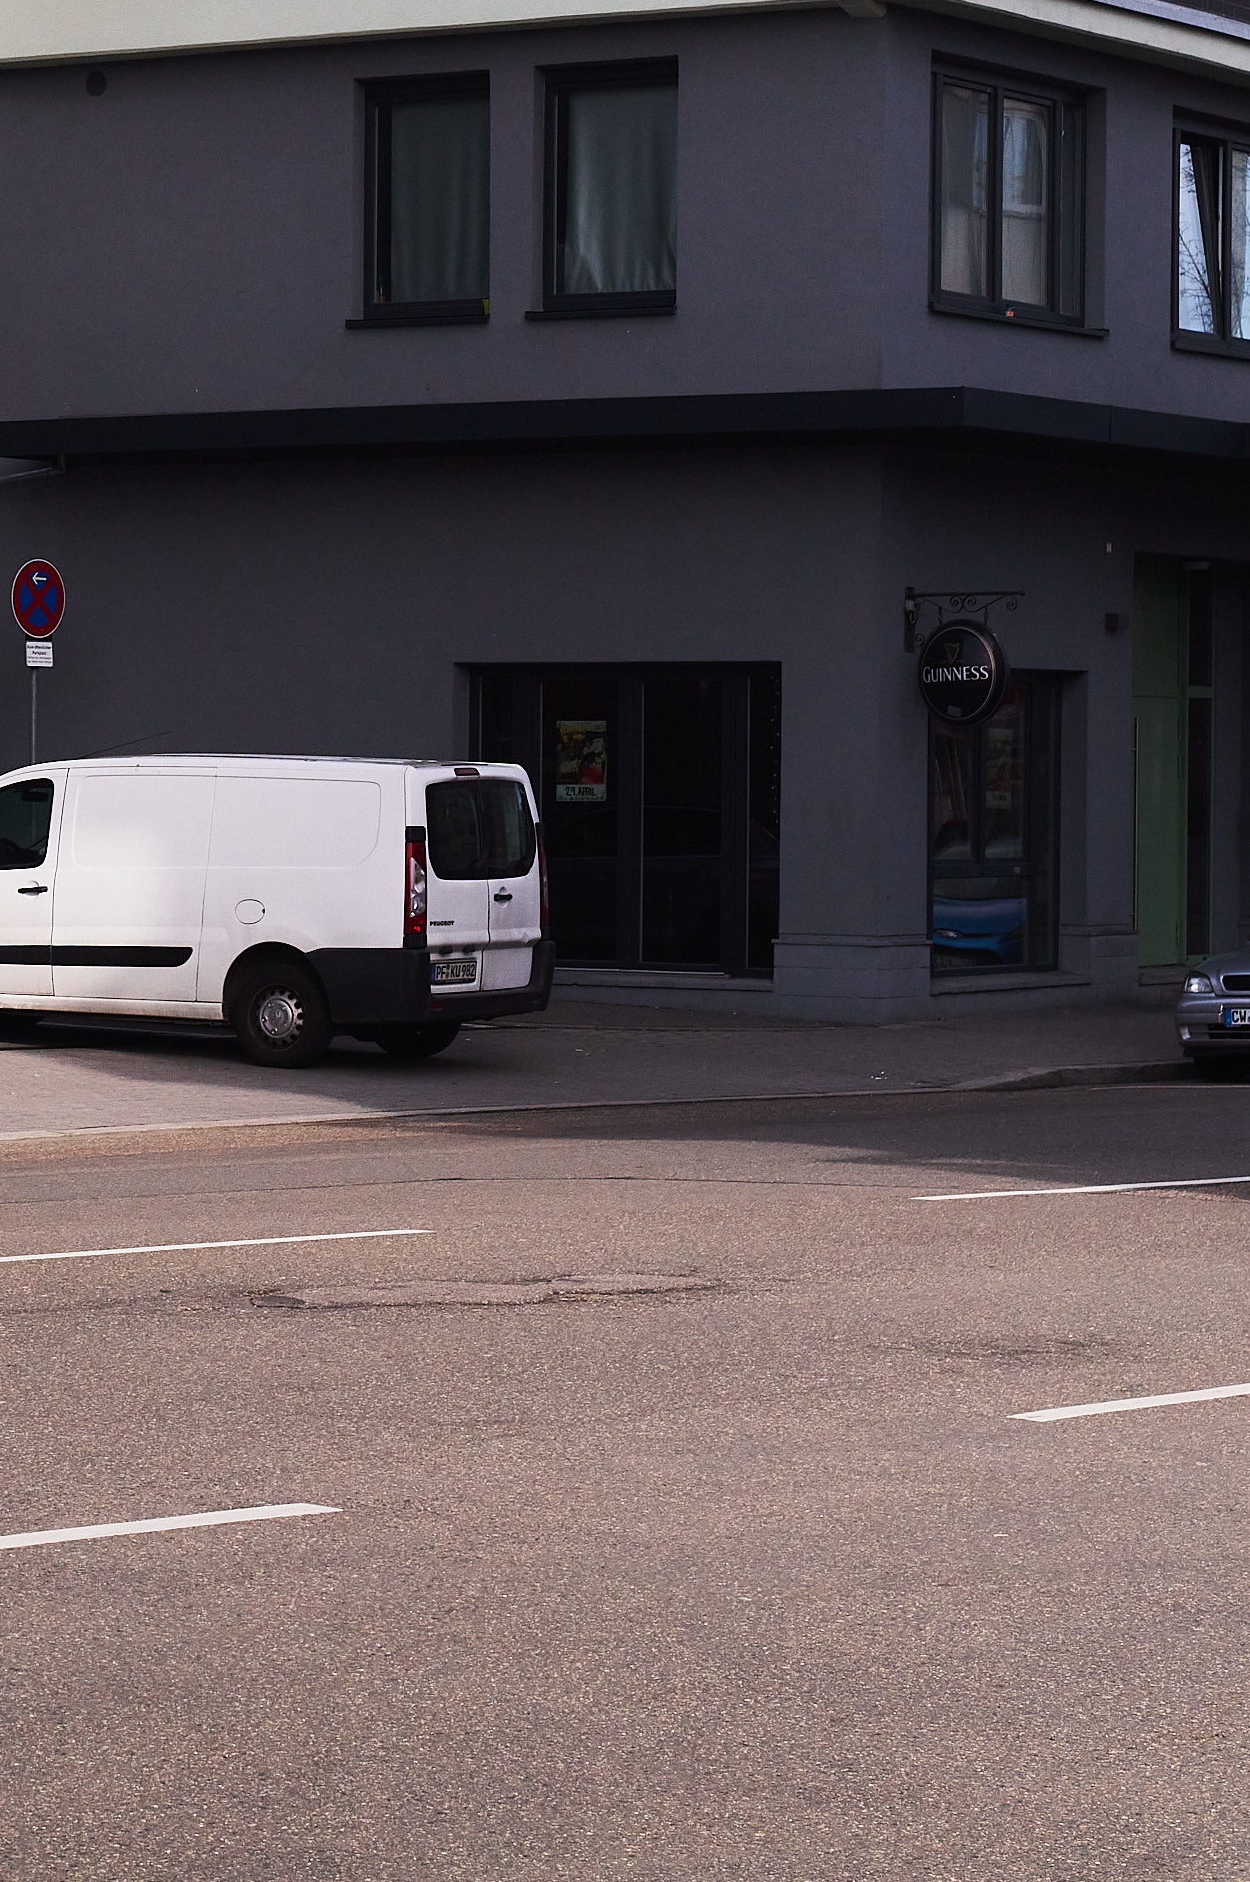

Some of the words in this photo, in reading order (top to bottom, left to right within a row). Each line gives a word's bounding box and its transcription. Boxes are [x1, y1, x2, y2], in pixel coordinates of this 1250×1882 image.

[922, 665, 989, 684] GUINNESS
[436, 965, 446, 979] PF
[450, 965, 461, 978] KU
[462, 964, 475, 978] 982
[1232, 1010, 1246, 1023] CW
